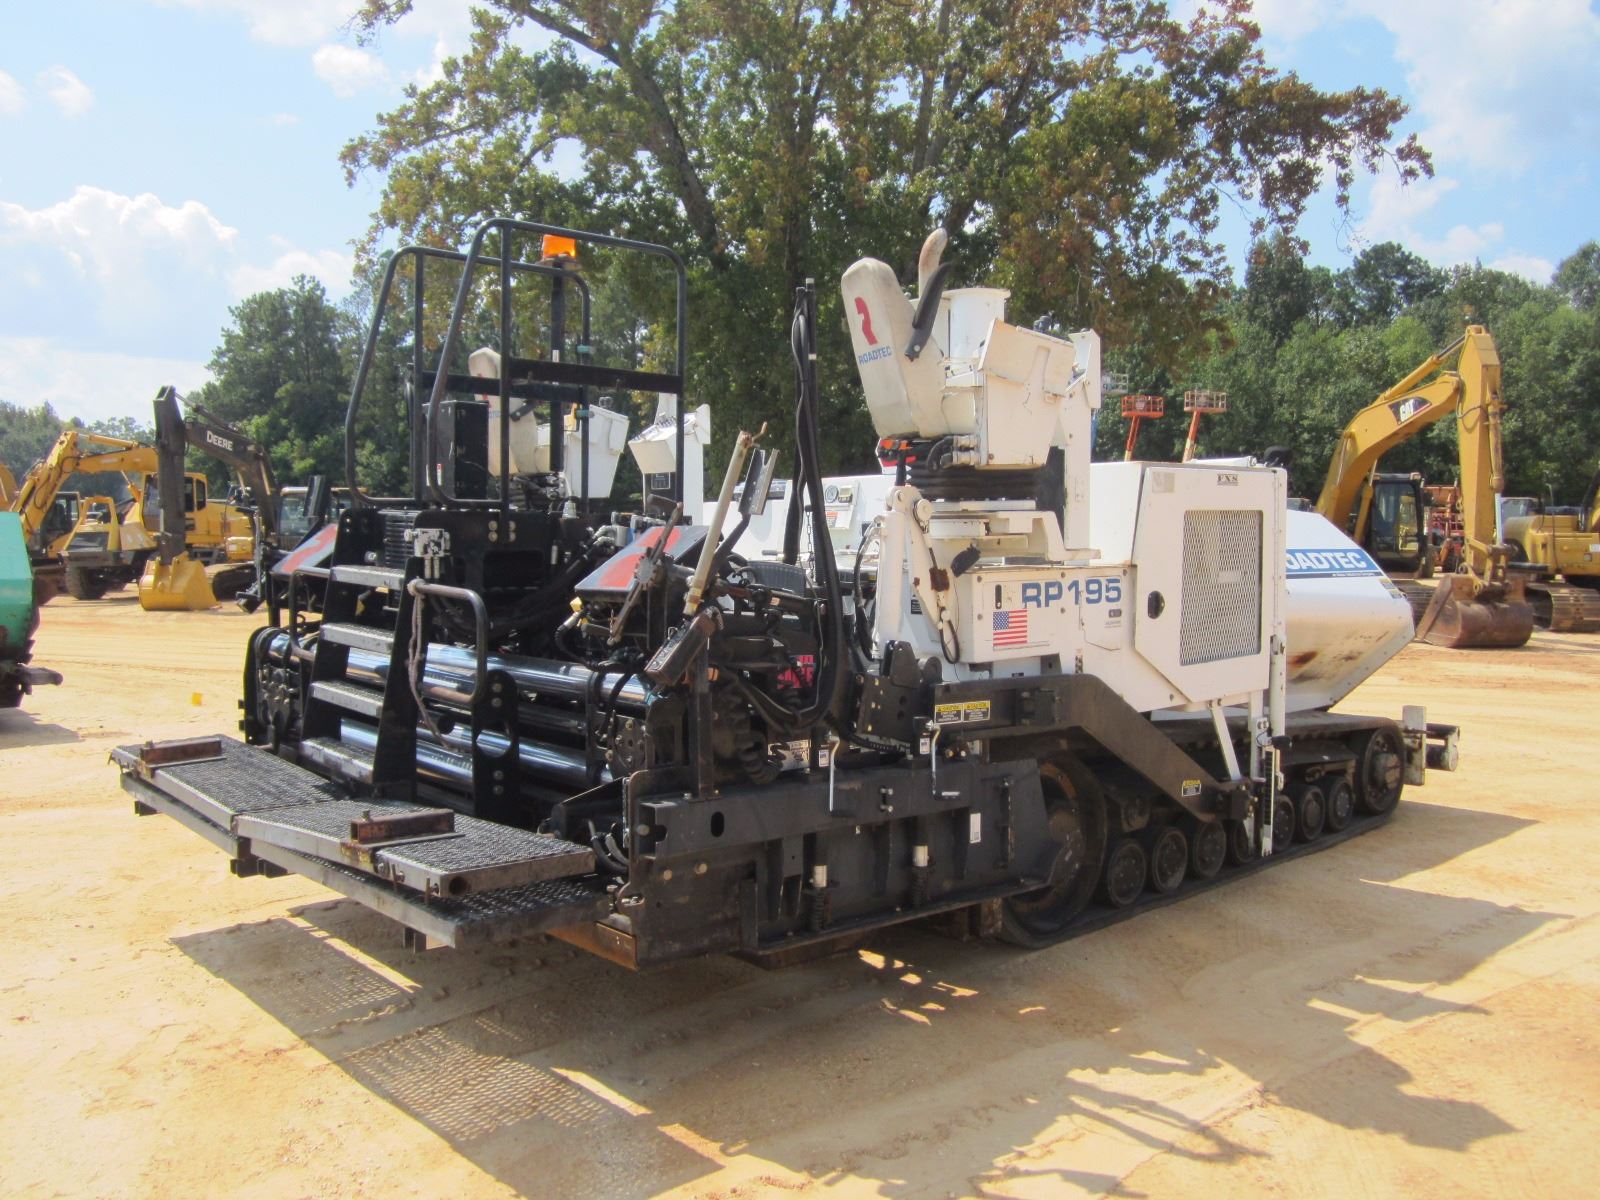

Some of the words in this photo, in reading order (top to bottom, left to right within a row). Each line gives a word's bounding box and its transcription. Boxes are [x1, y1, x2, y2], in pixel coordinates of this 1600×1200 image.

[858, 346, 892, 365] ROADTEC
[206, 430, 233, 451] DEERE
[1286, 552, 1367, 569] OADTEC
[1021, 578, 1122, 609] RP195
